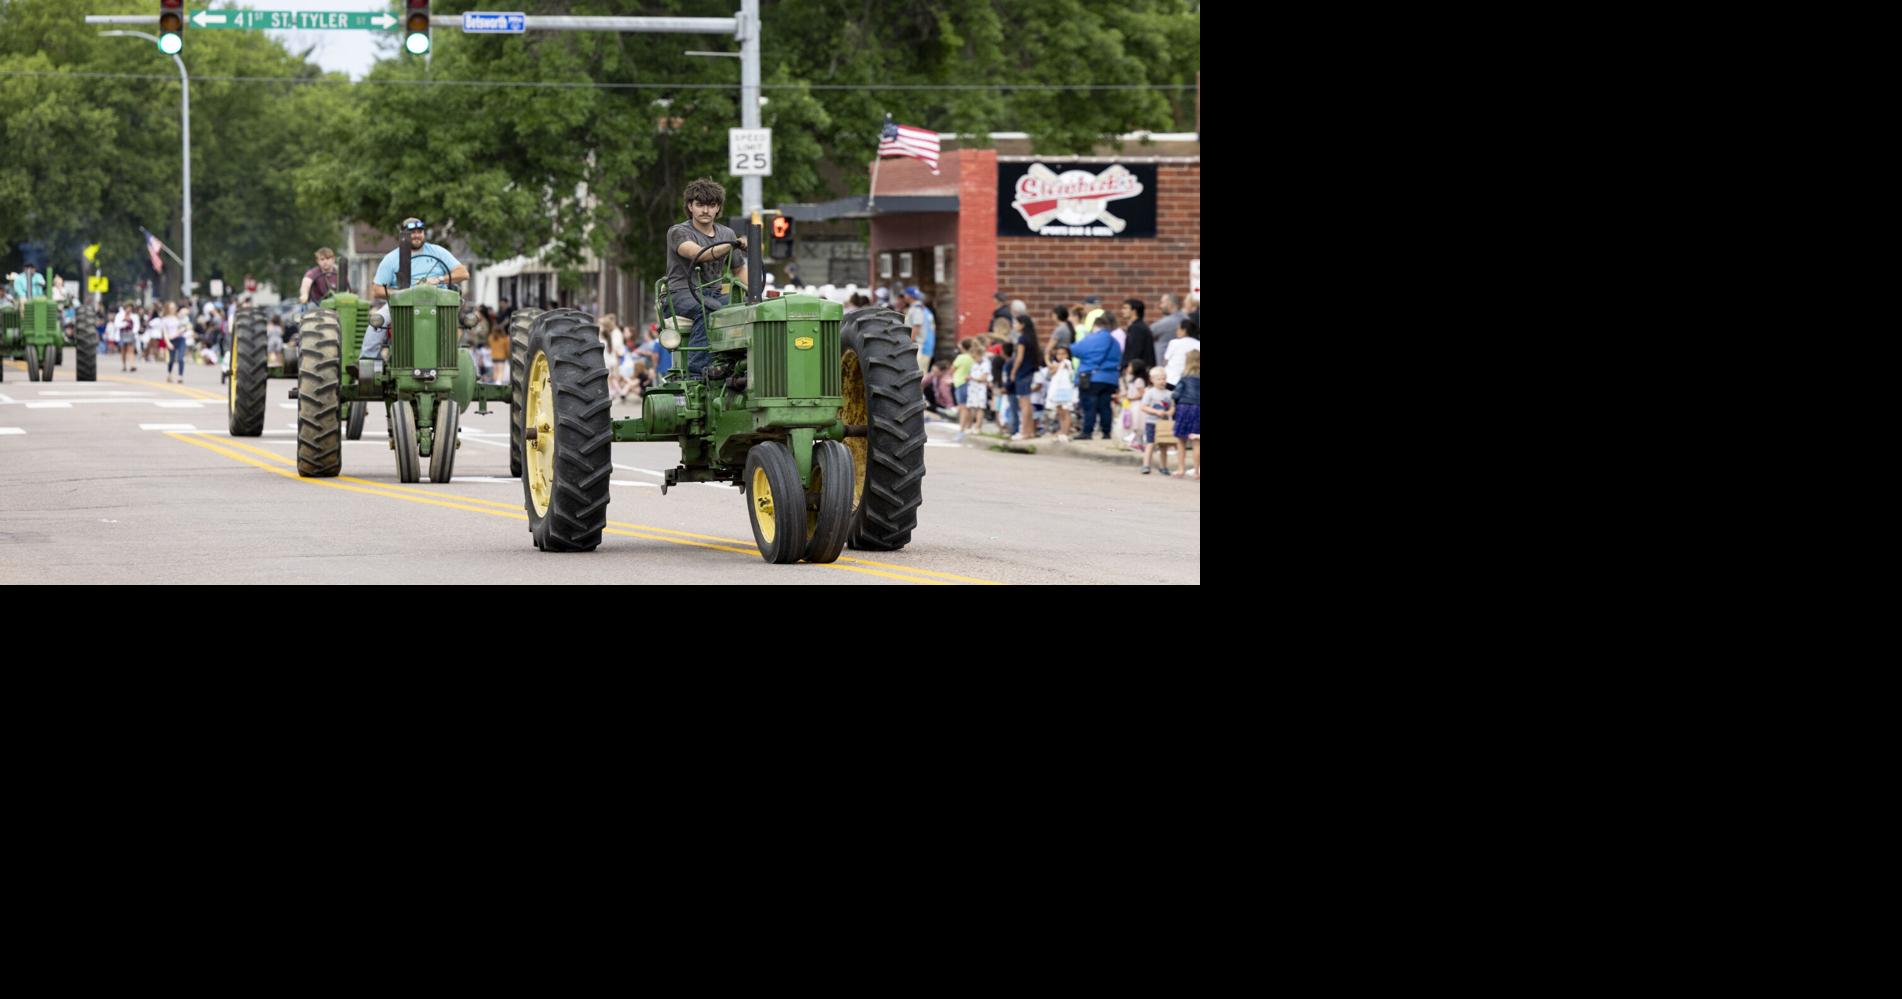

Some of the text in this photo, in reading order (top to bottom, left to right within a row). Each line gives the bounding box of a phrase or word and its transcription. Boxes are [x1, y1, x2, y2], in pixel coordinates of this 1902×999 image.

[301, 13, 348, 28] TYLER
[735, 134, 767, 142] SPEED
[736, 143, 763, 151] LIMIT
[736, 153, 767, 169] 25
[1068, 226, 1084, 236] BAR
